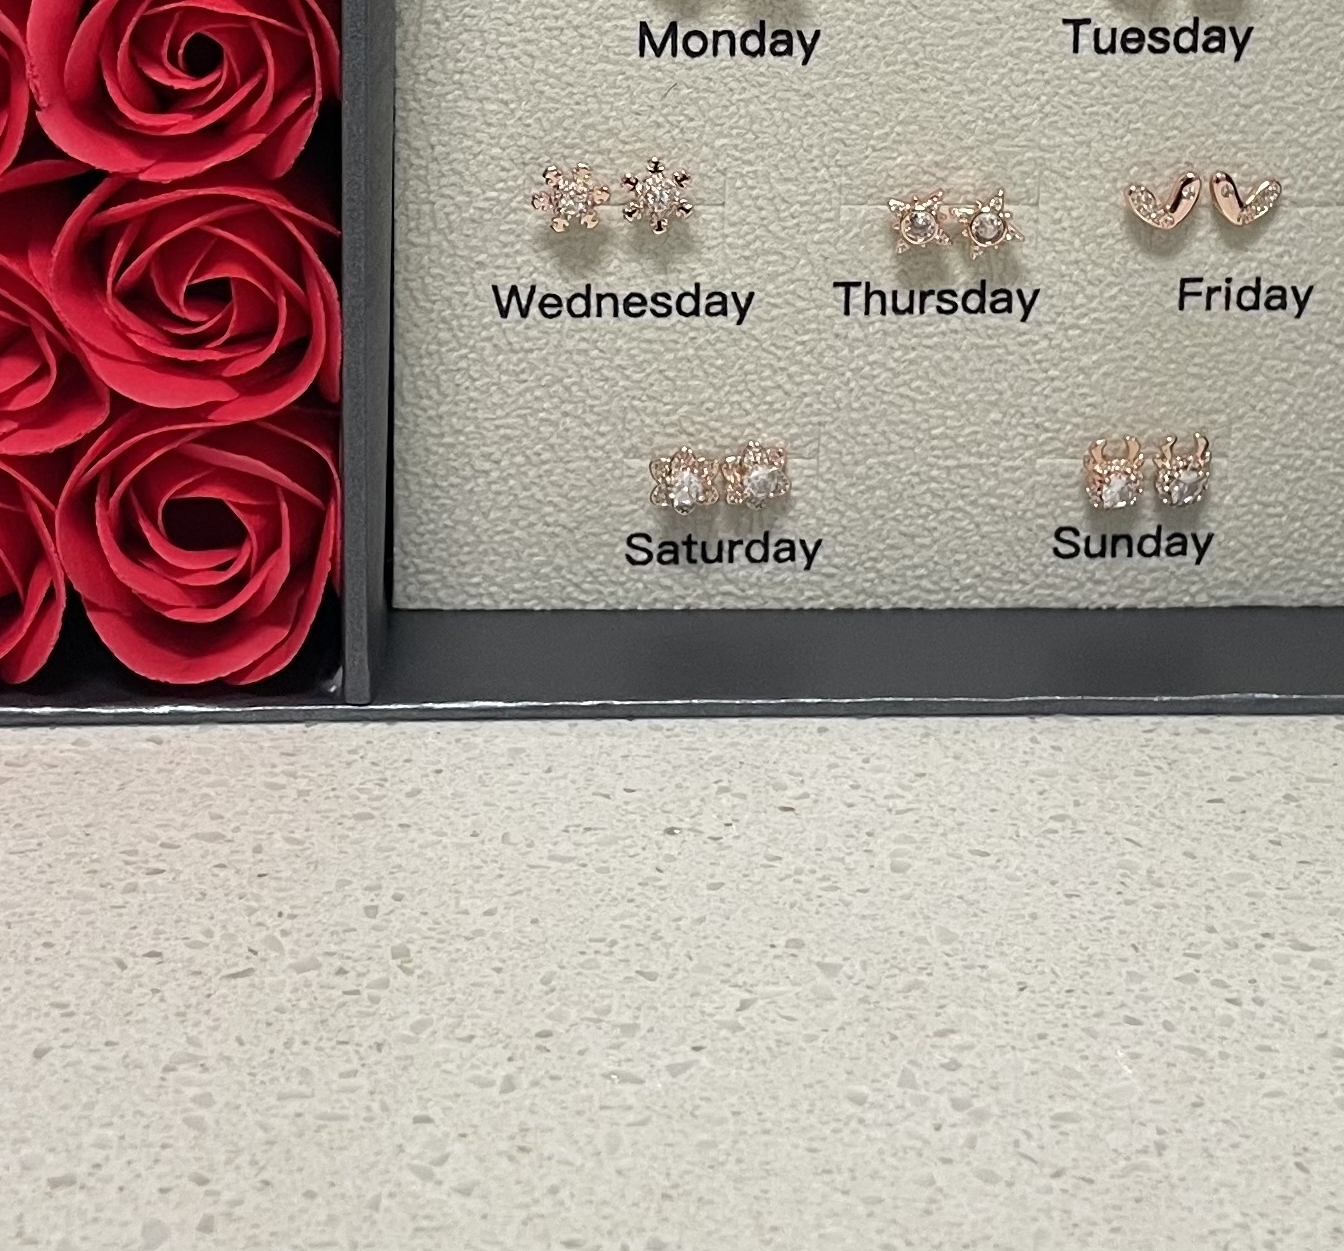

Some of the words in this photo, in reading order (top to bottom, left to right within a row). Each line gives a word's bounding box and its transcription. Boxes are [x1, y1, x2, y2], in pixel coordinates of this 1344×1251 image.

[638, 19, 821, 67] Monday
[1061, 15, 1255, 63] Tuesday
[491, 281, 756, 326] Wednesday
[832, 278, 1041, 323] Thursday
[1178, 275, 1315, 320] Friday
[624, 529, 823, 572] Saturday
[1052, 523, 1215, 566] Sunday
